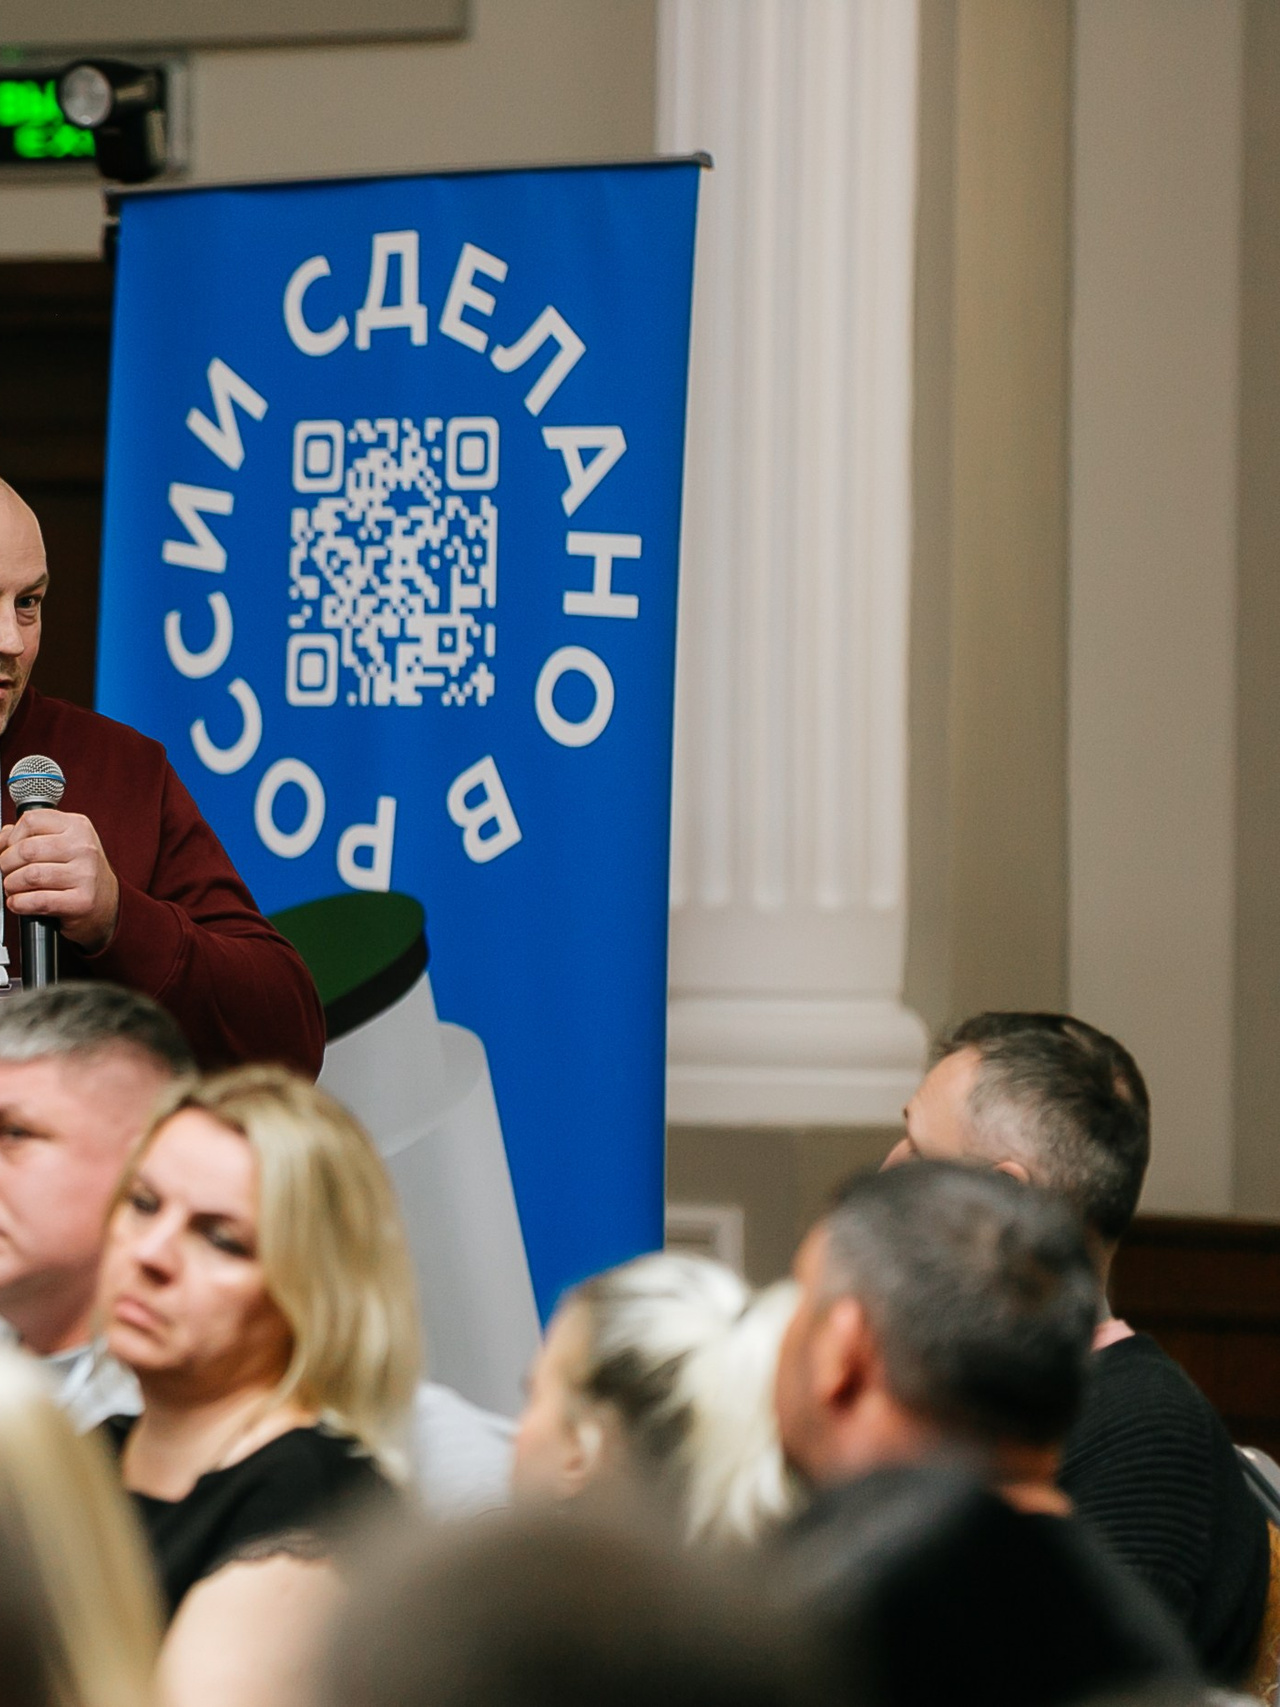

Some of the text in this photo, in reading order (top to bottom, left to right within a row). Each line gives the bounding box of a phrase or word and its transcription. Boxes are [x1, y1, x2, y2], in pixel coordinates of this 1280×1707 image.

[162, 230, 642, 892] СДЕЛАНО В РОССИИ
